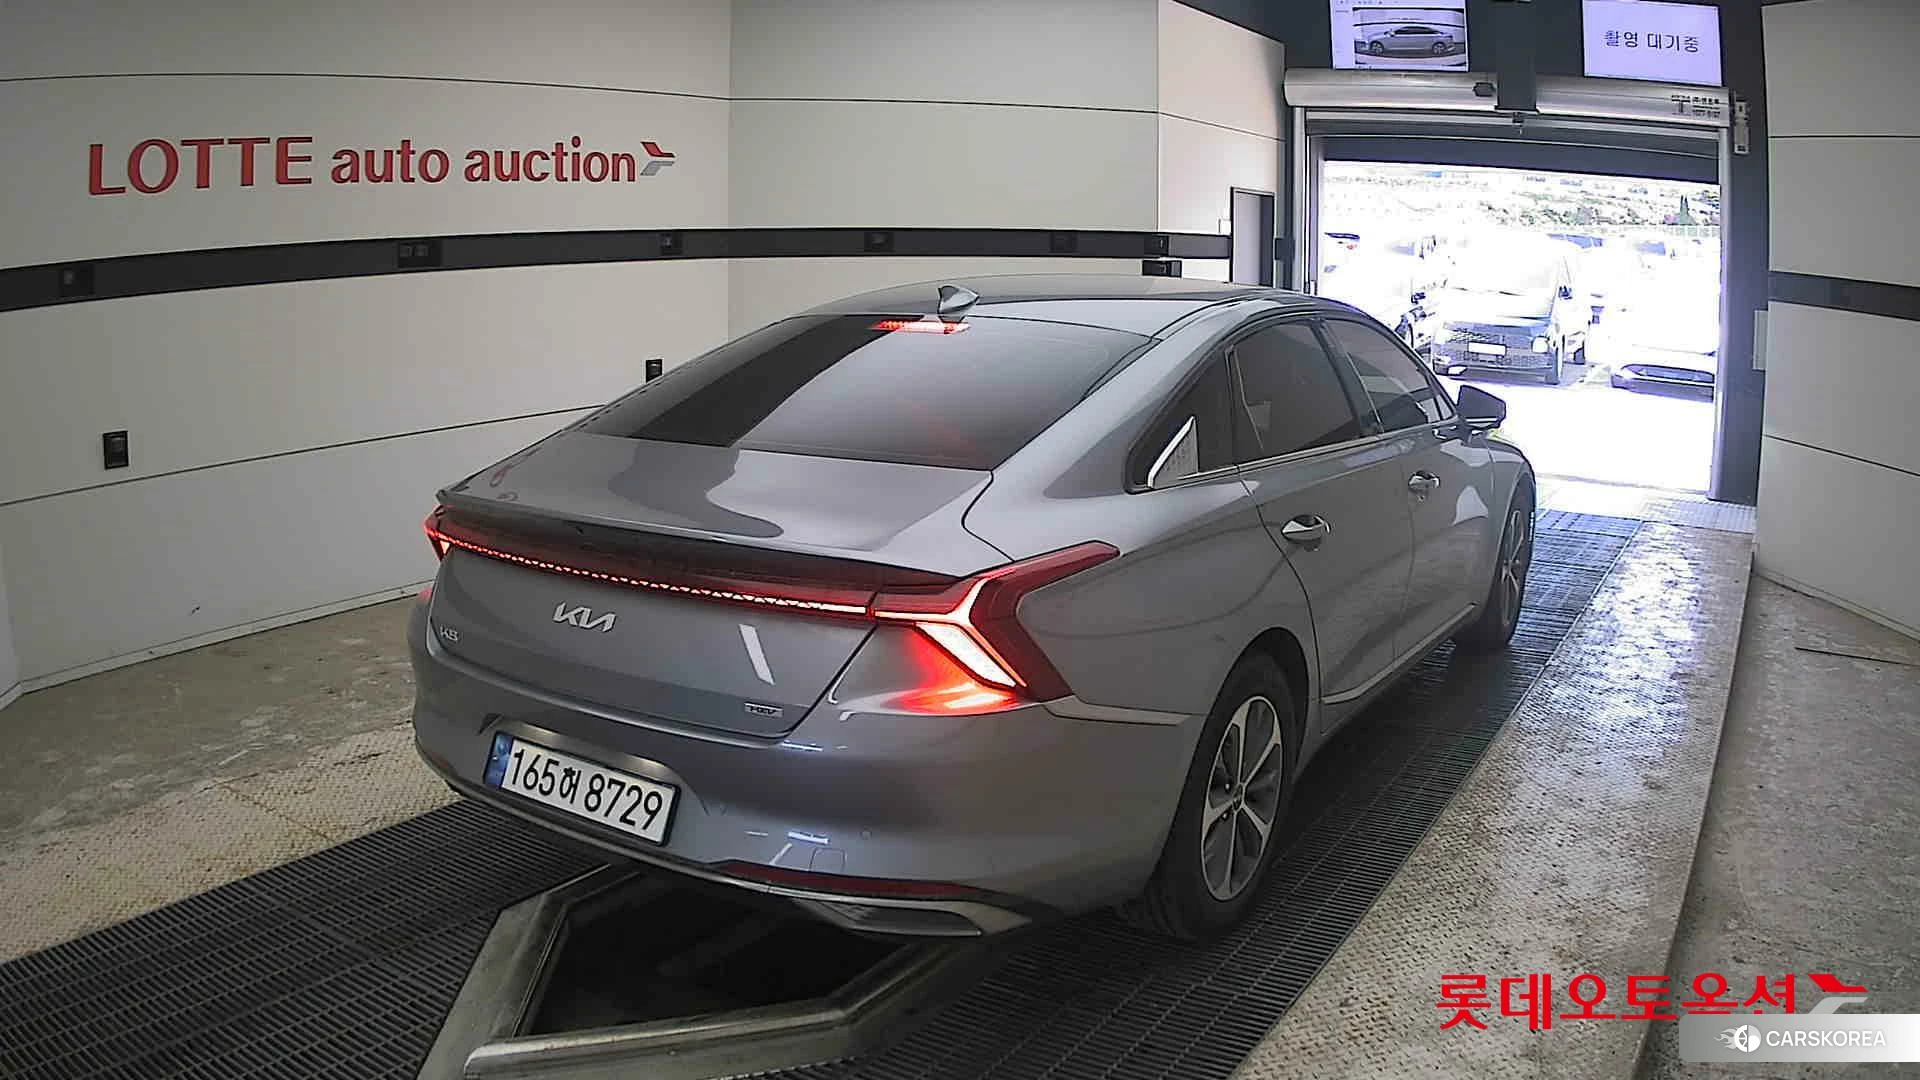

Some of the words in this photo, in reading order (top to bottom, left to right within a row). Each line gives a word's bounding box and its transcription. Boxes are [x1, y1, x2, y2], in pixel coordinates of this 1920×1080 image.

[1647, 33, 1698, 53] 대기중
[88, 136, 313, 195] LOTTE
[331, 140, 449, 184] auto
[463, 136, 635, 183] auction
[553, 602, 617, 633] KIA
[512, 748, 582, 805] 165허
[583, 772, 664, 831] 8729
